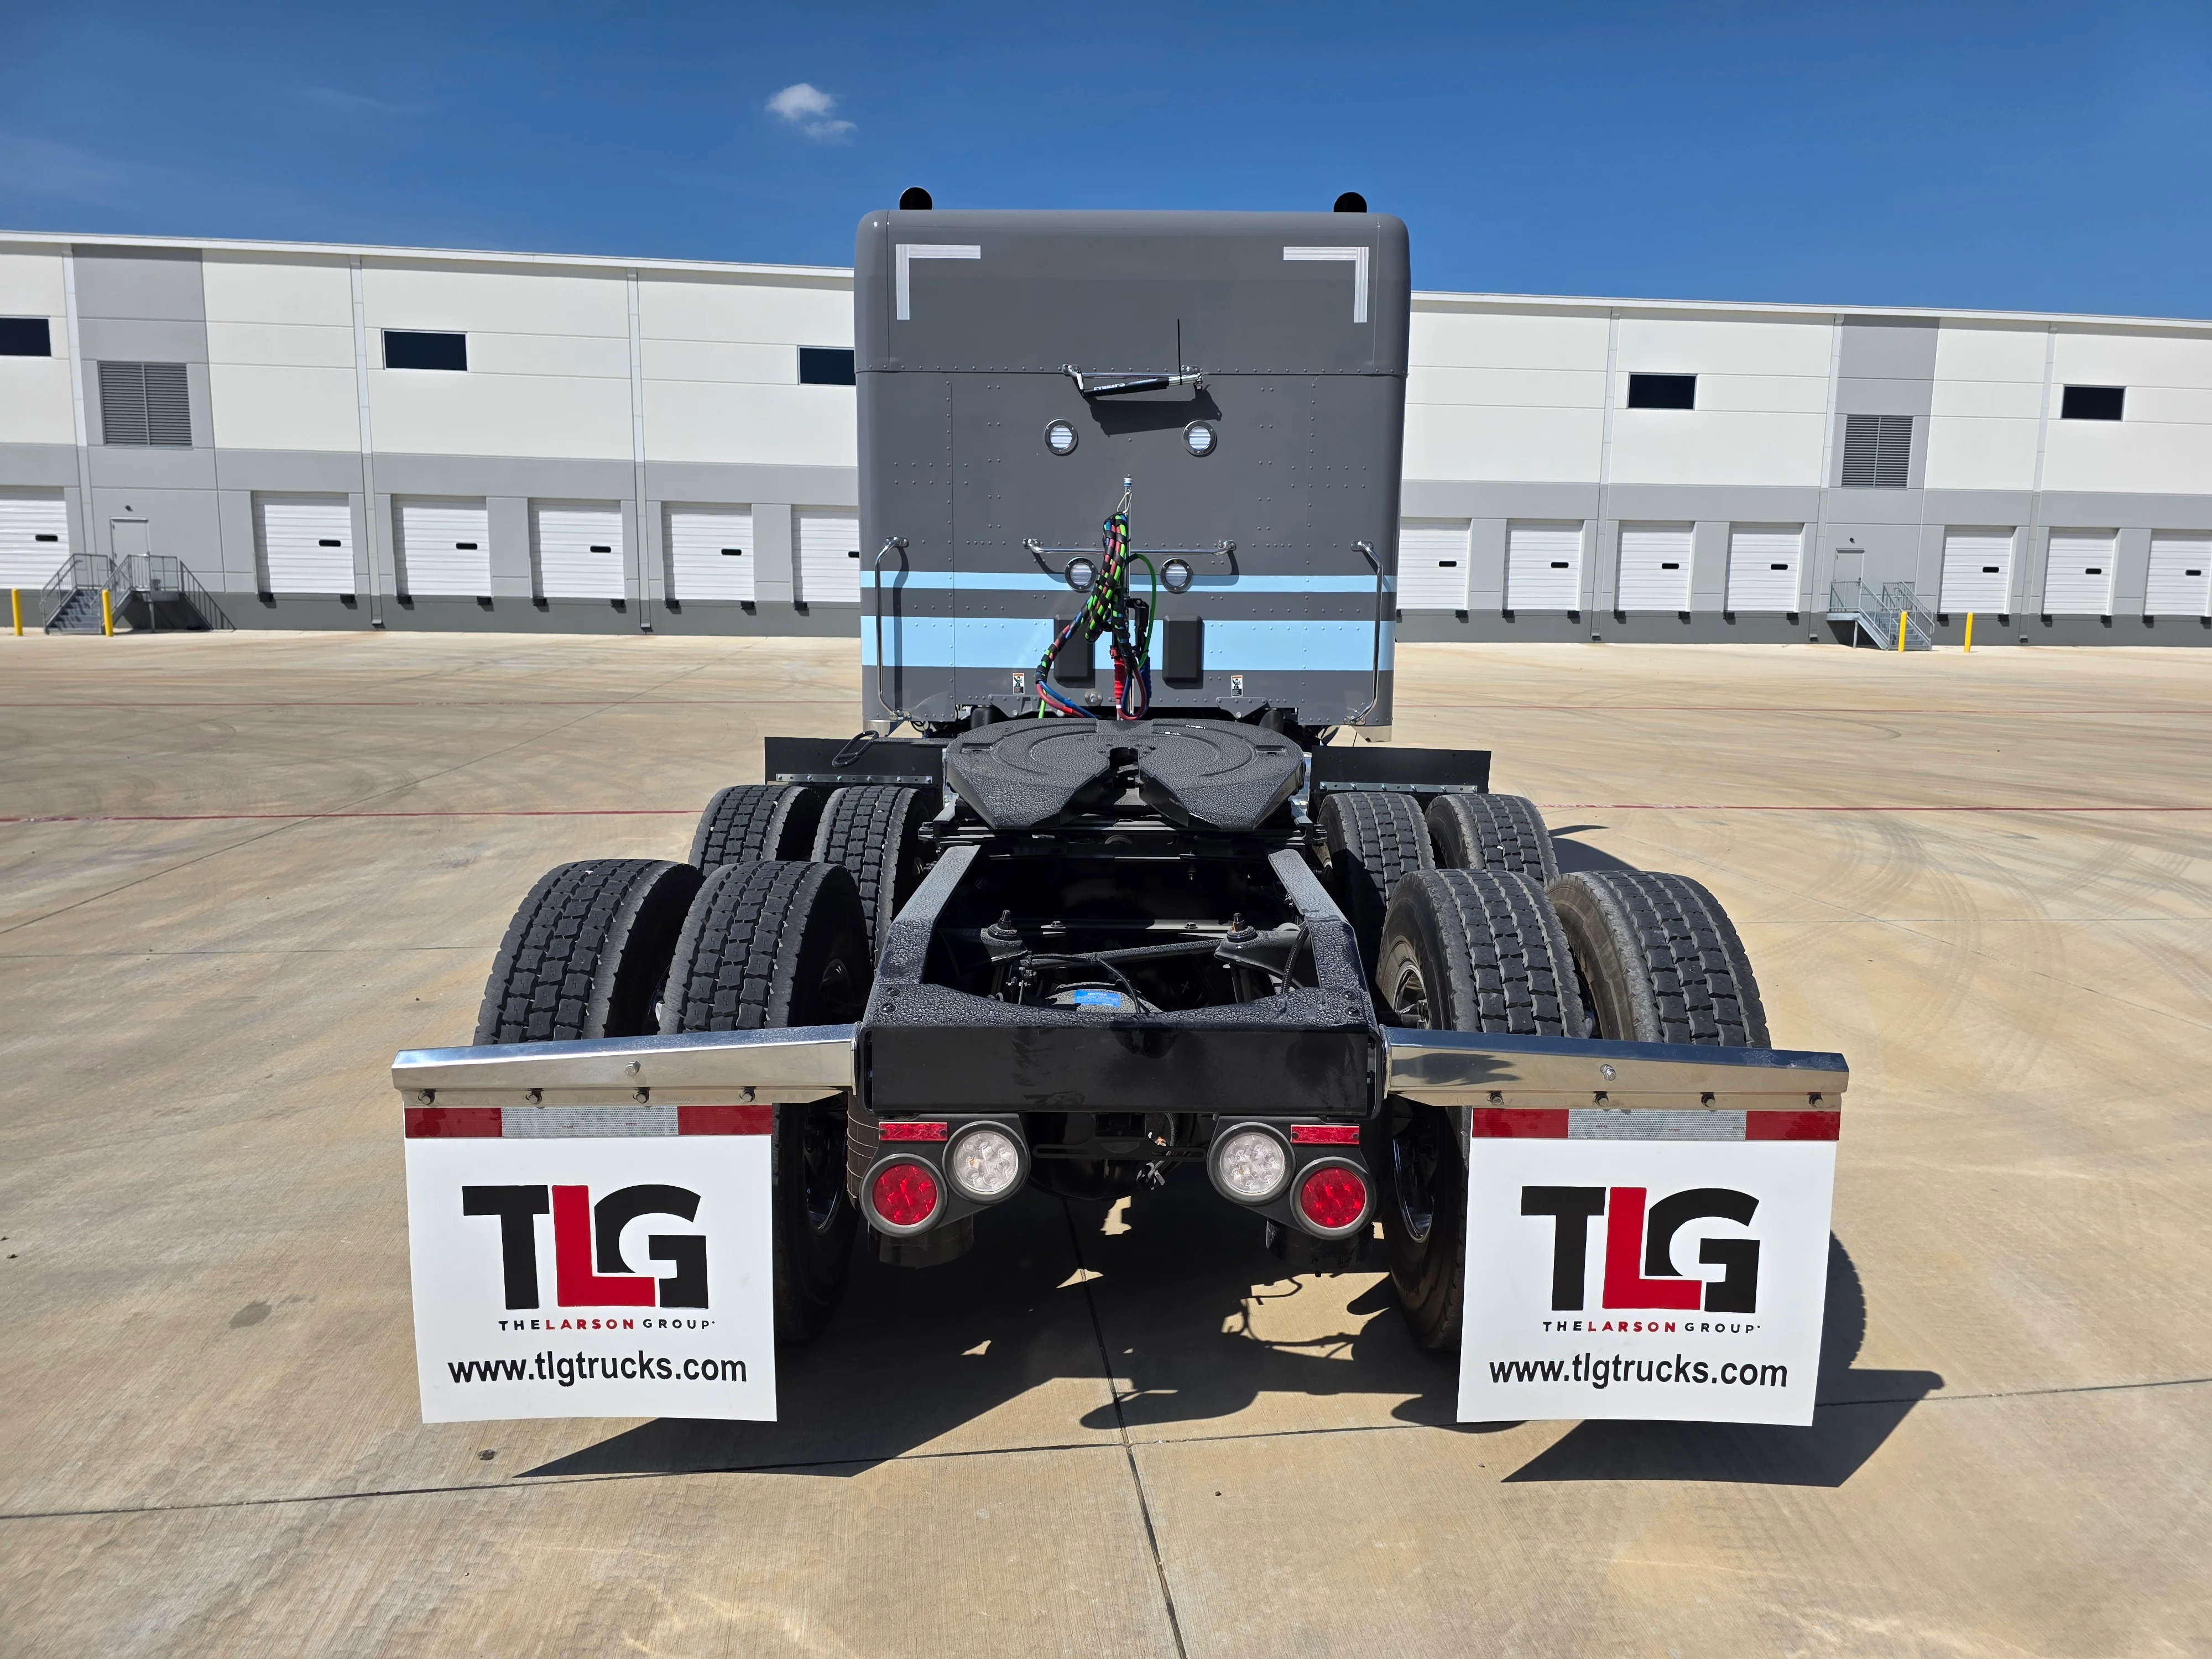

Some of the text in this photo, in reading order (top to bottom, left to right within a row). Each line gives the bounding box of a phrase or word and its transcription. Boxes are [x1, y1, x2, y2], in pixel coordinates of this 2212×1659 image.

[462, 1184, 709, 1310] TLG
[1520, 1186, 1760, 1313] TLG
[643, 1319, 709, 1329] GROUP
[1684, 1322, 1754, 1334] GROUP
[447, 1350, 747, 1387] www.tlgtrucks.com
[1489, 1353, 1787, 1389] www.tlgtrucks.com
